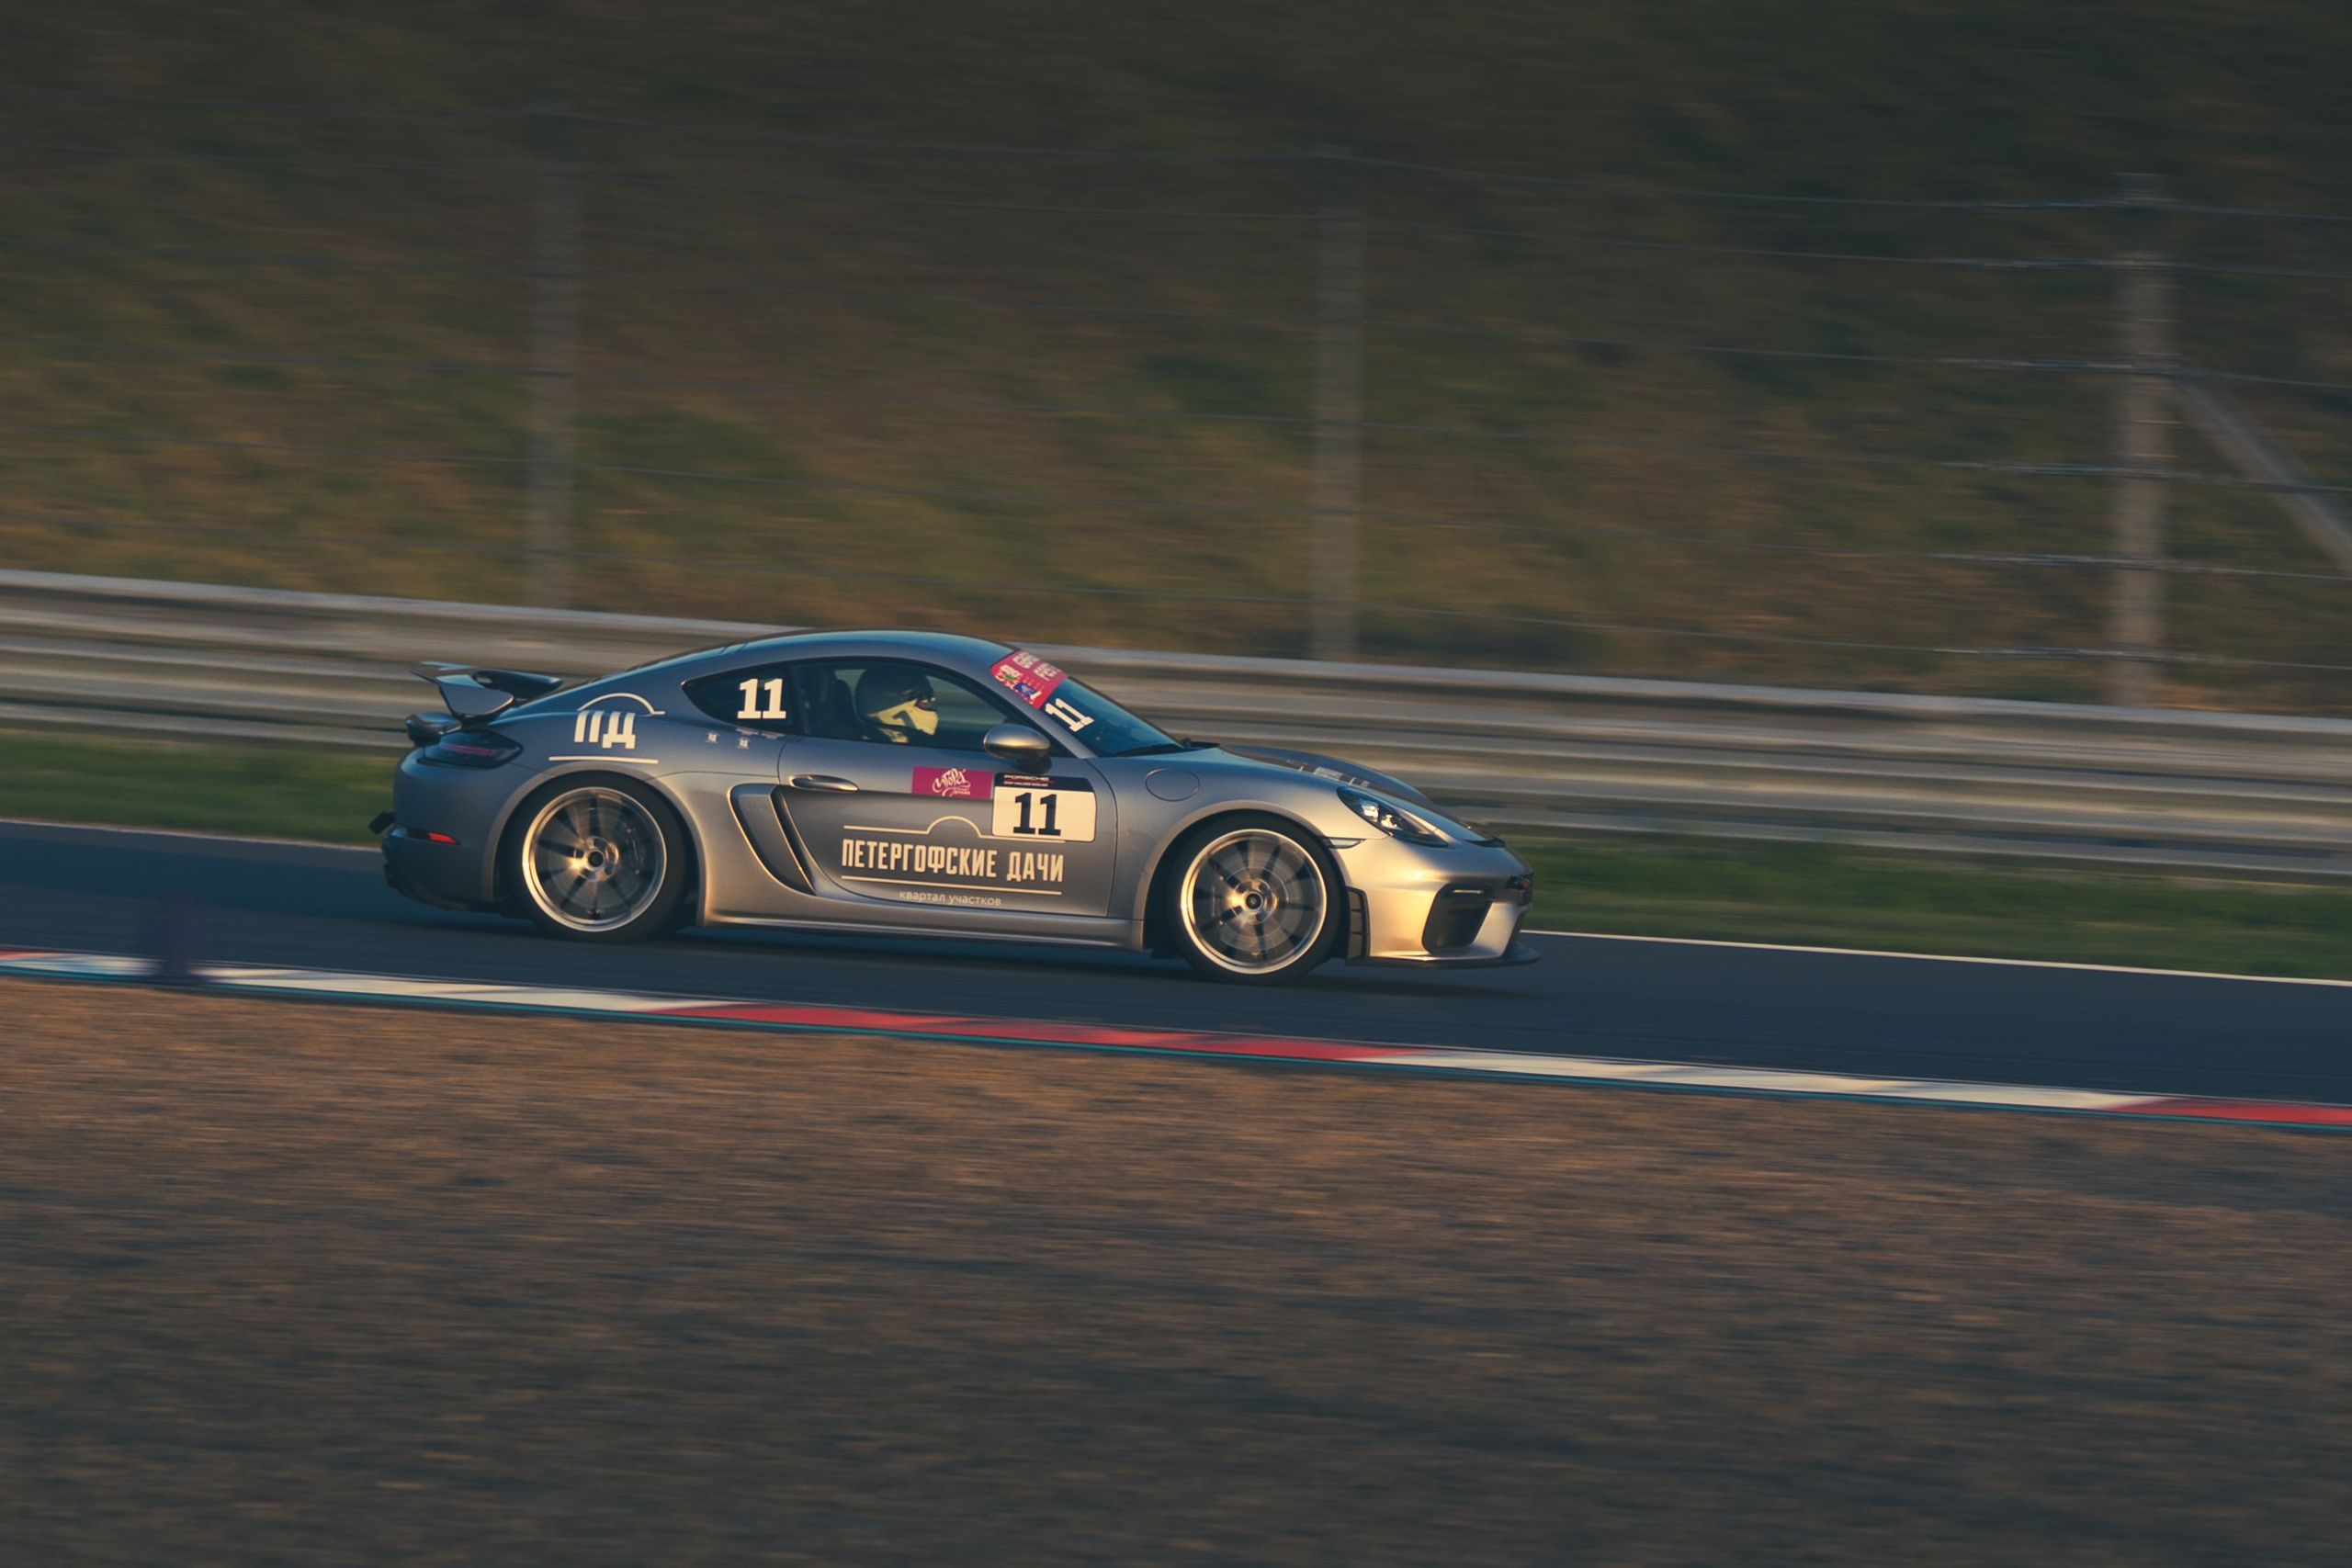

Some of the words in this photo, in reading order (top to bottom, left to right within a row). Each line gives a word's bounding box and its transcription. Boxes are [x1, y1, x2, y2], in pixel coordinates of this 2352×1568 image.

[738, 678, 786, 719] 11
[1045, 698, 1094, 732] 11
[1013, 792, 1061, 836] 11
[842, 839, 998, 877] ПЕТЕРГОФСКИЕ
[1006, 852, 1064, 882] ДАЧИ
[899, 891, 945, 902] квартал
[948, 896, 1001, 907] участков
